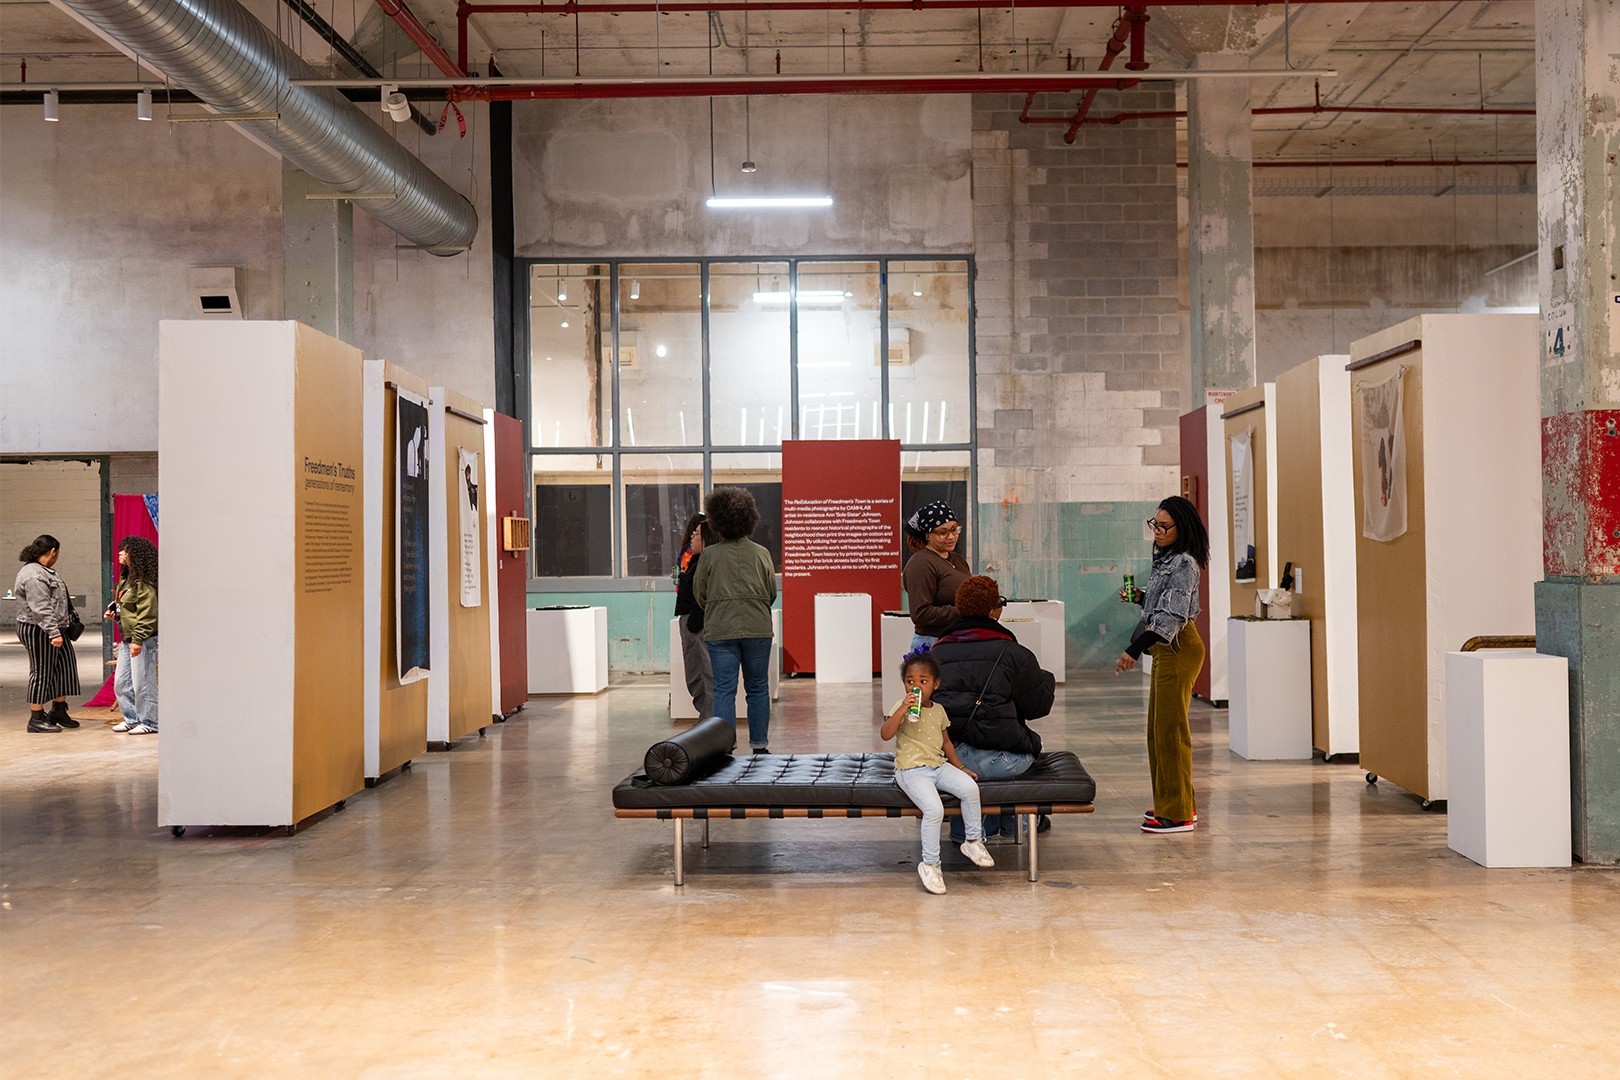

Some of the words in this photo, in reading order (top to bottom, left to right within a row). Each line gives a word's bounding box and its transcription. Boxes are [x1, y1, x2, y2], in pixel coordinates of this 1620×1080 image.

[1553, 327, 1565, 357] 4
[304, 456, 338, 478] Freedmen's
[338, 462, 356, 480] Truths
